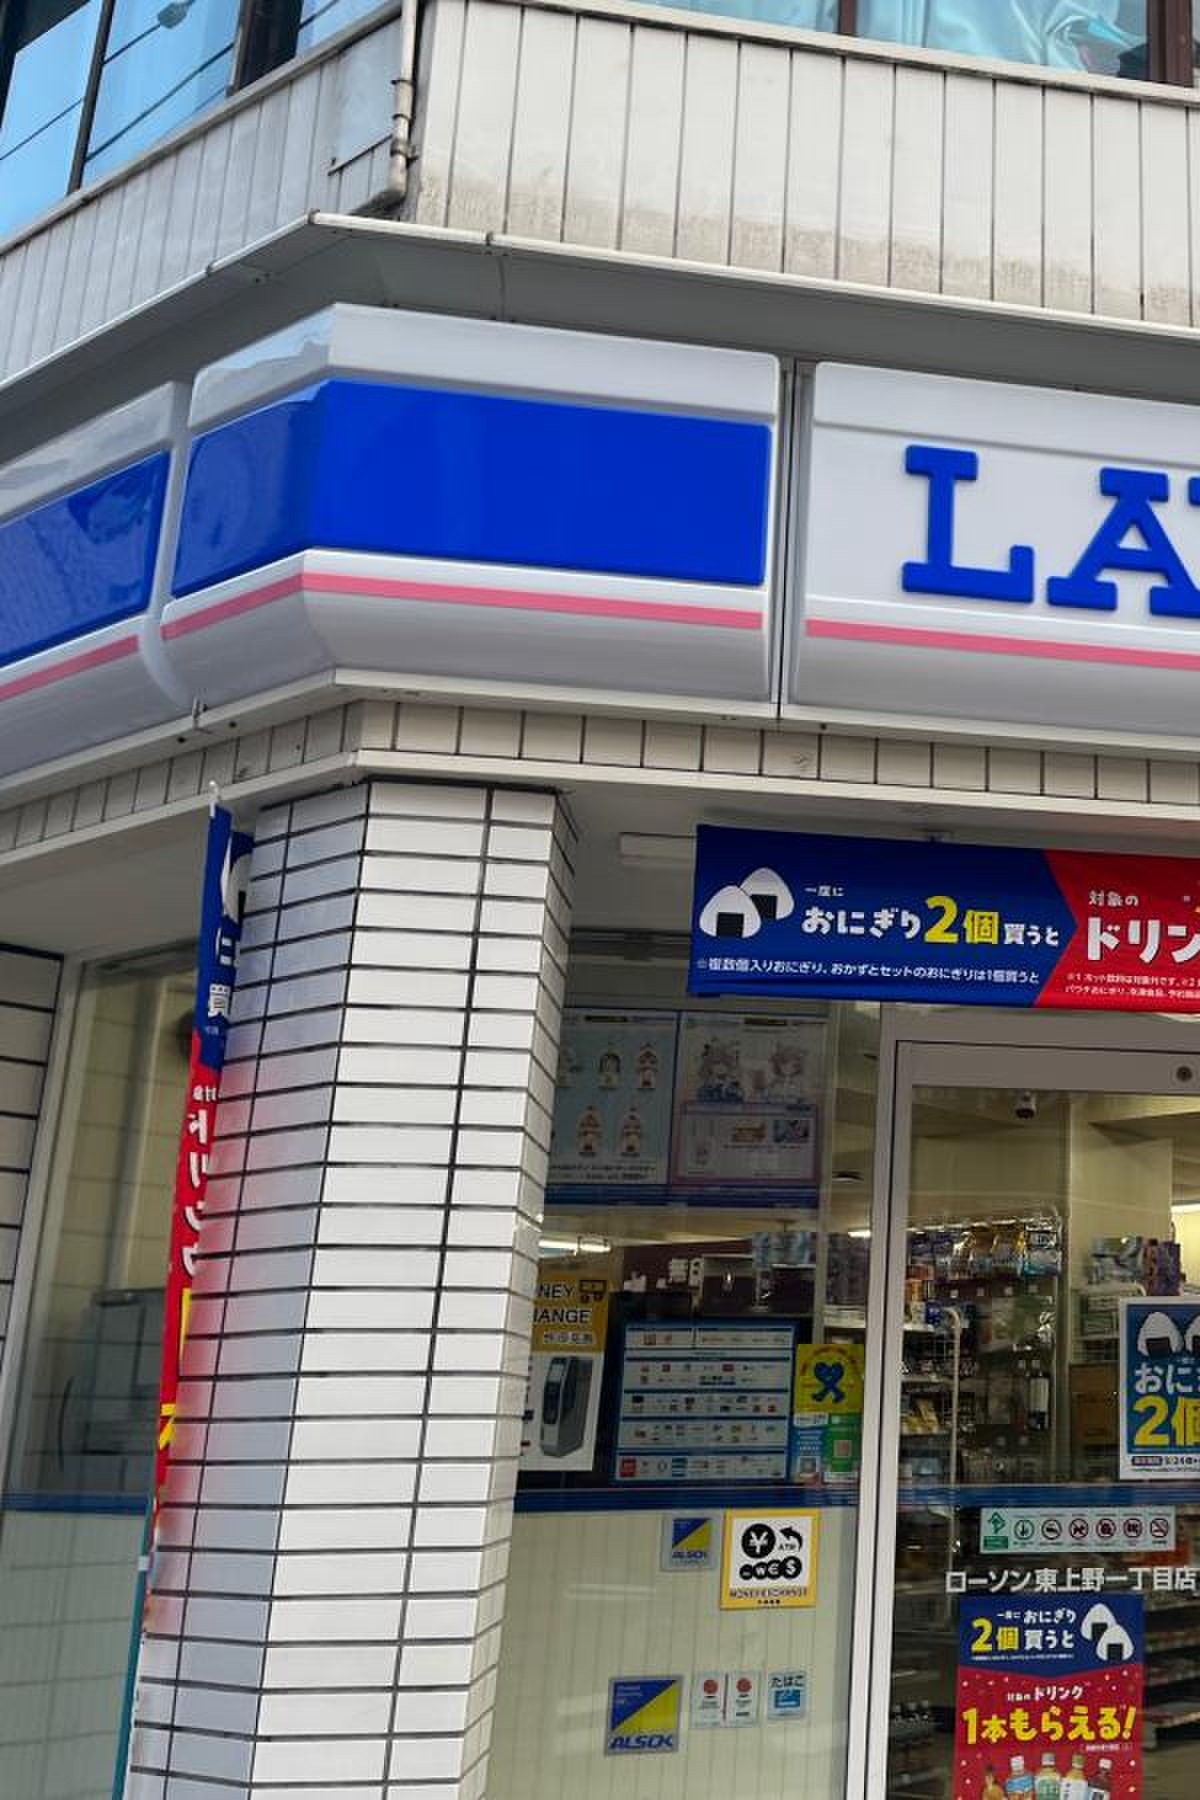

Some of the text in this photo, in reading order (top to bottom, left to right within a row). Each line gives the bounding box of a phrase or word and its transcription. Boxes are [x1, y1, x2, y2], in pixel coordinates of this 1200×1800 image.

[1088, 889, 1140, 907] 対象の
[801, 895, 1060, 947] おにぎり2個買うと
[945, 1566, 1198, 1593] ローソン東上野一丁目店
[970, 1618, 1076, 1653] 2個買うと
[1034, 1685, 1084, 1702] ドリンク
[962, 1704, 1137, 1745] 1本もらえる!
[608, 1734, 675, 1750] ALSOK
